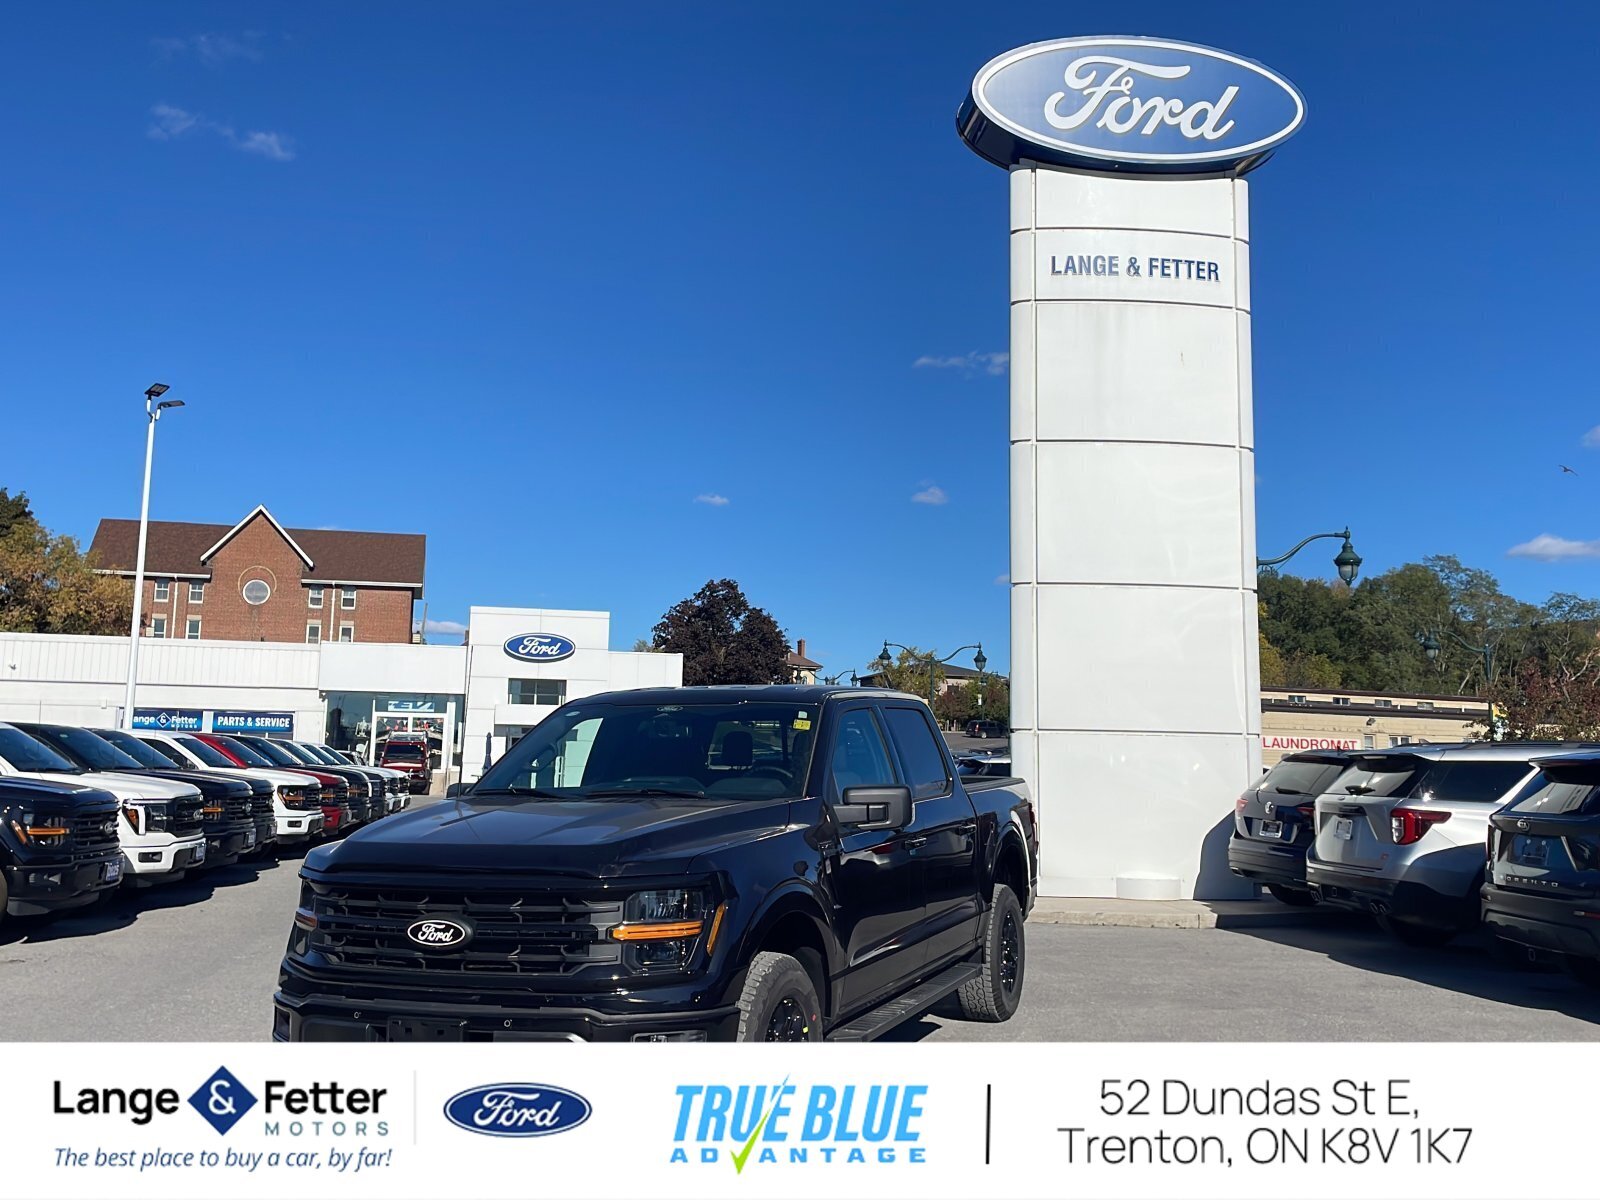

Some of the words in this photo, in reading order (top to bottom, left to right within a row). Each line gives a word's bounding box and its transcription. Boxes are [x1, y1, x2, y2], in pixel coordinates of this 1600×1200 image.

[1044, 55, 1240, 140] Ford
[1051, 255, 1119, 277] LANGE
[1127, 257, 1142, 277] &
[1149, 257, 1220, 282] FETTER
[519, 637, 561, 655] Ford
[133, 715, 155, 726] ange
[171, 715, 198, 724] Fetter
[217, 716, 245, 727] PARTS
[246, 717, 253, 727] &
[255, 717, 290, 728] SERVICE
[1262, 736, 1358, 751] LAUNDROMAT
[418, 923, 454, 941] Ford
